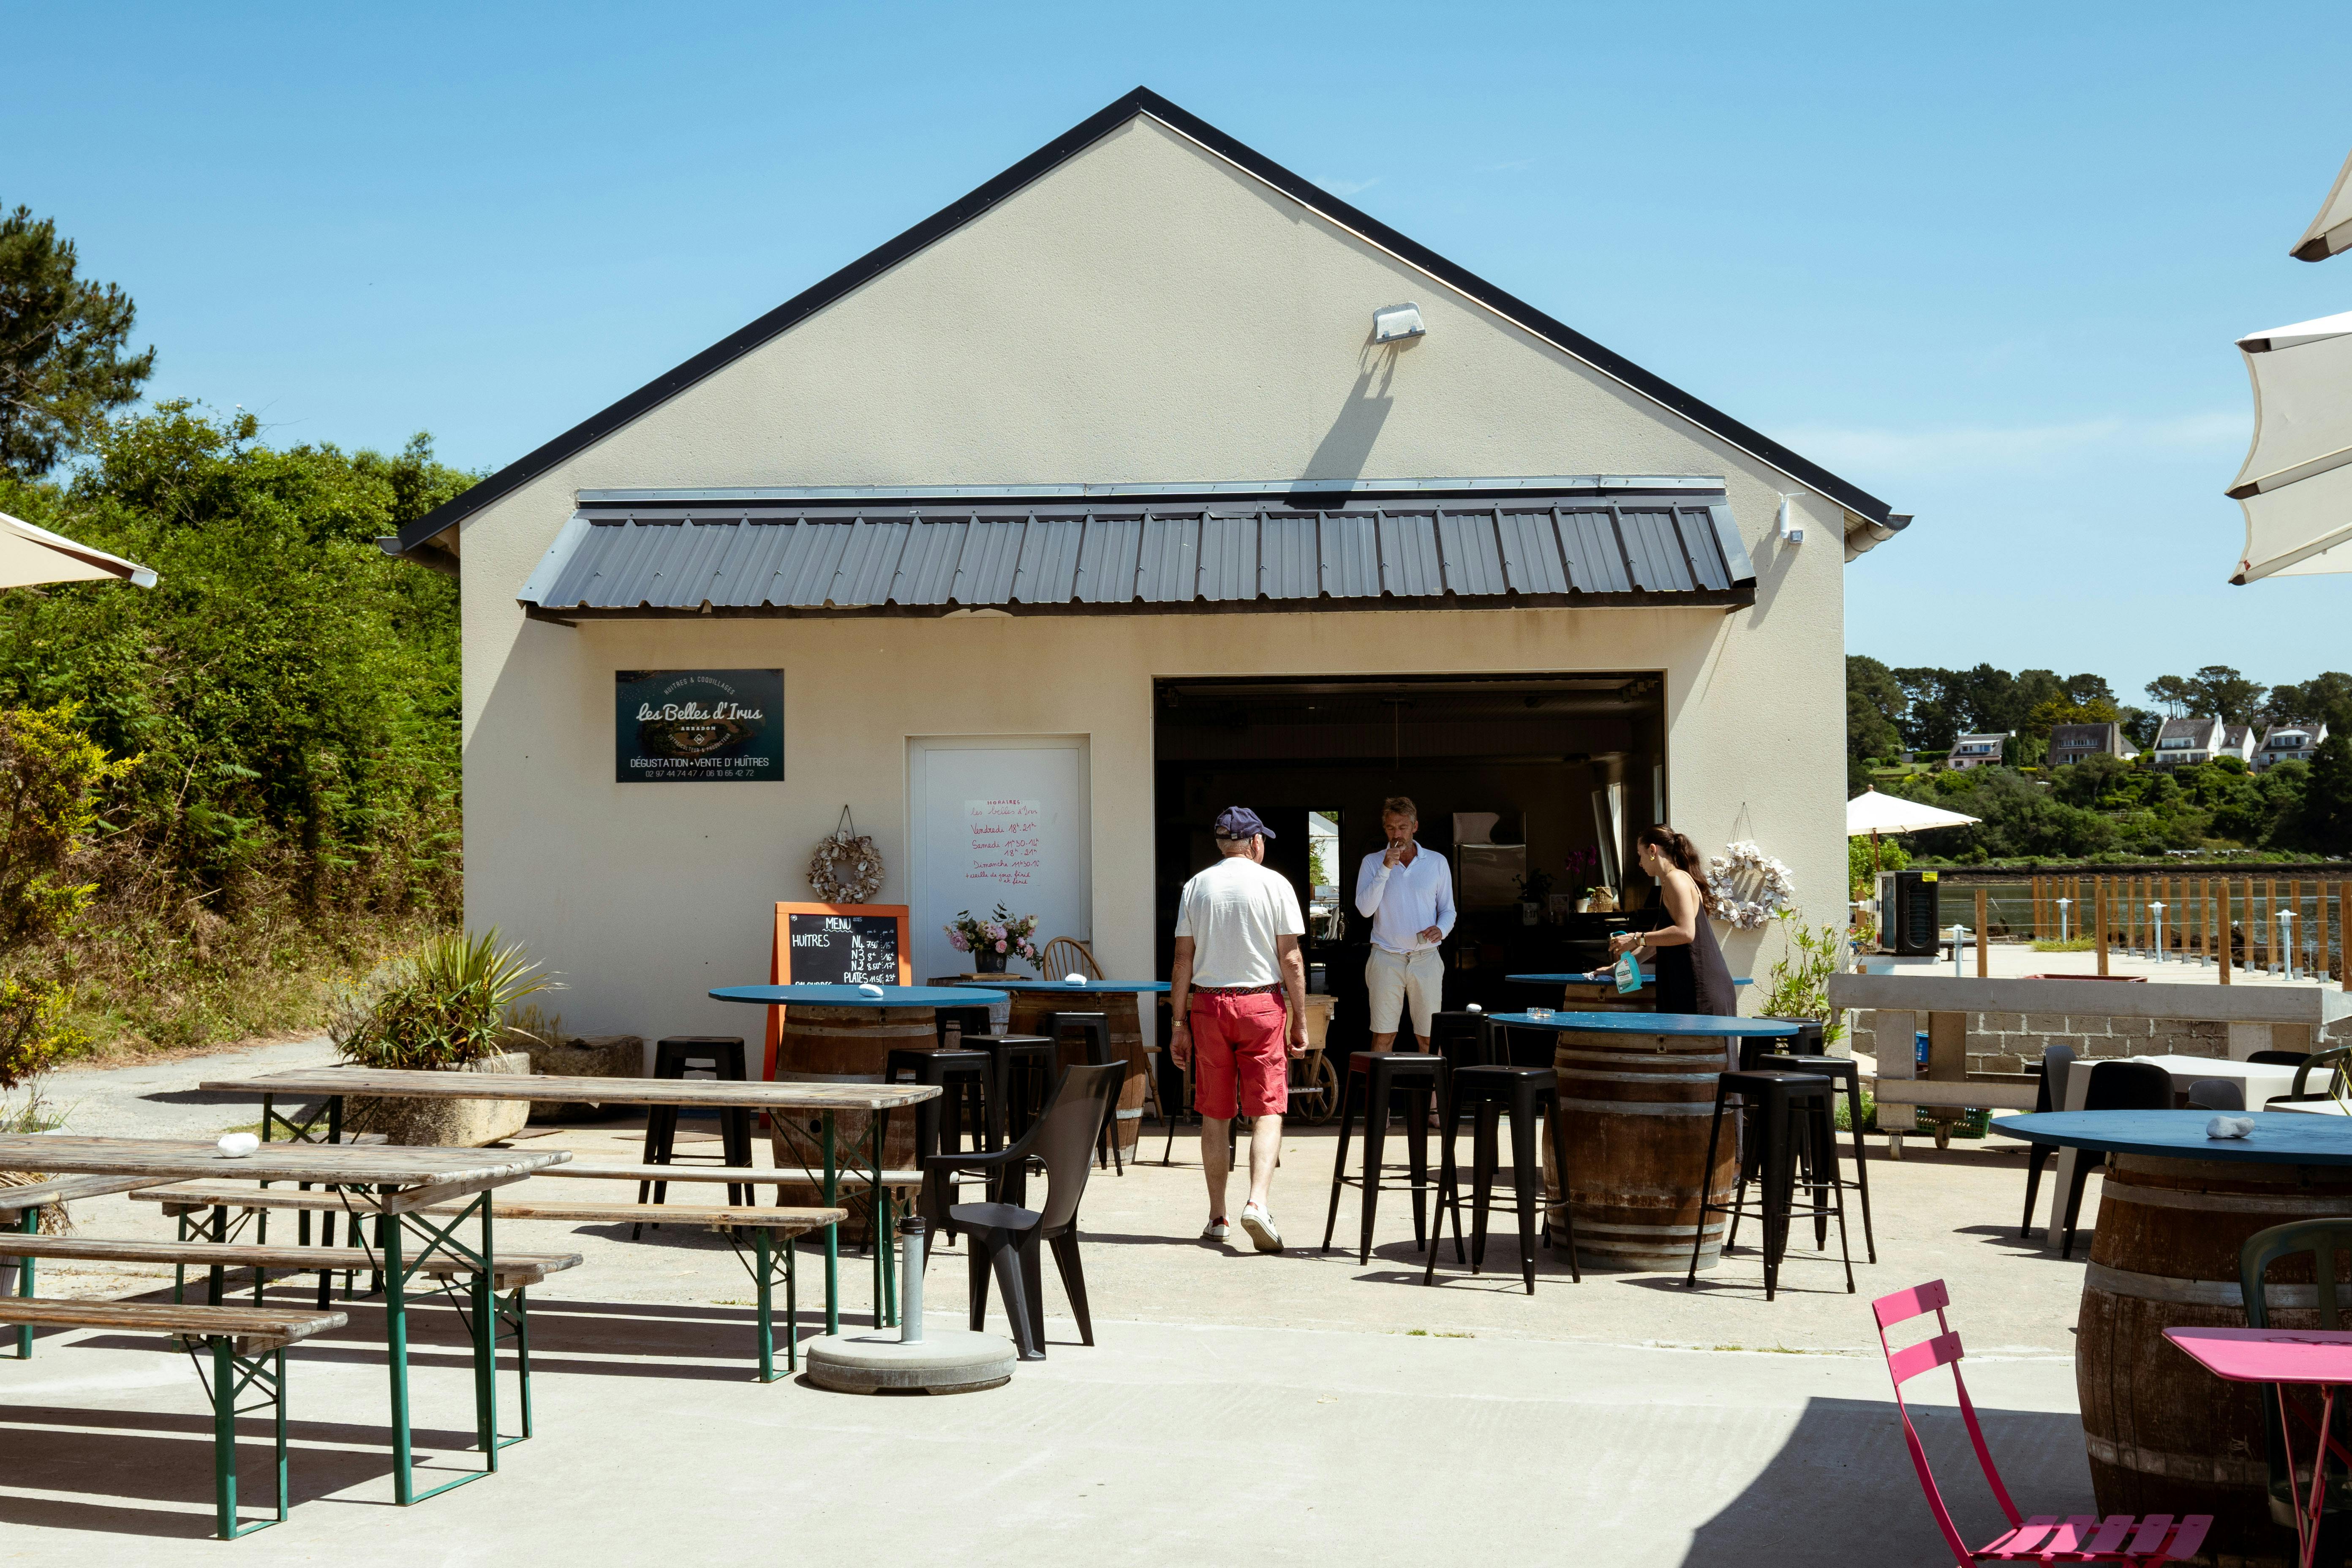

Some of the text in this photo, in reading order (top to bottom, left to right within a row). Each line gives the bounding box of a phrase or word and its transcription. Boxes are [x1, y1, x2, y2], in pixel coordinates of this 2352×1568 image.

[664, 678, 687, 695] HUITRES
[697, 676, 735, 694] COQUILLAGES
[636, 702, 762, 721] les Belles d'Irus
[706, 733, 731, 751] PRODUCTEUR
[630, 756, 688, 768] DÉGUSTATION
[694, 758, 722, 767] VENTE
[734, 755, 769, 766] HUÎTRES
[826, 917, 851, 930] MENU
[844, 972, 868, 984] PLATES
